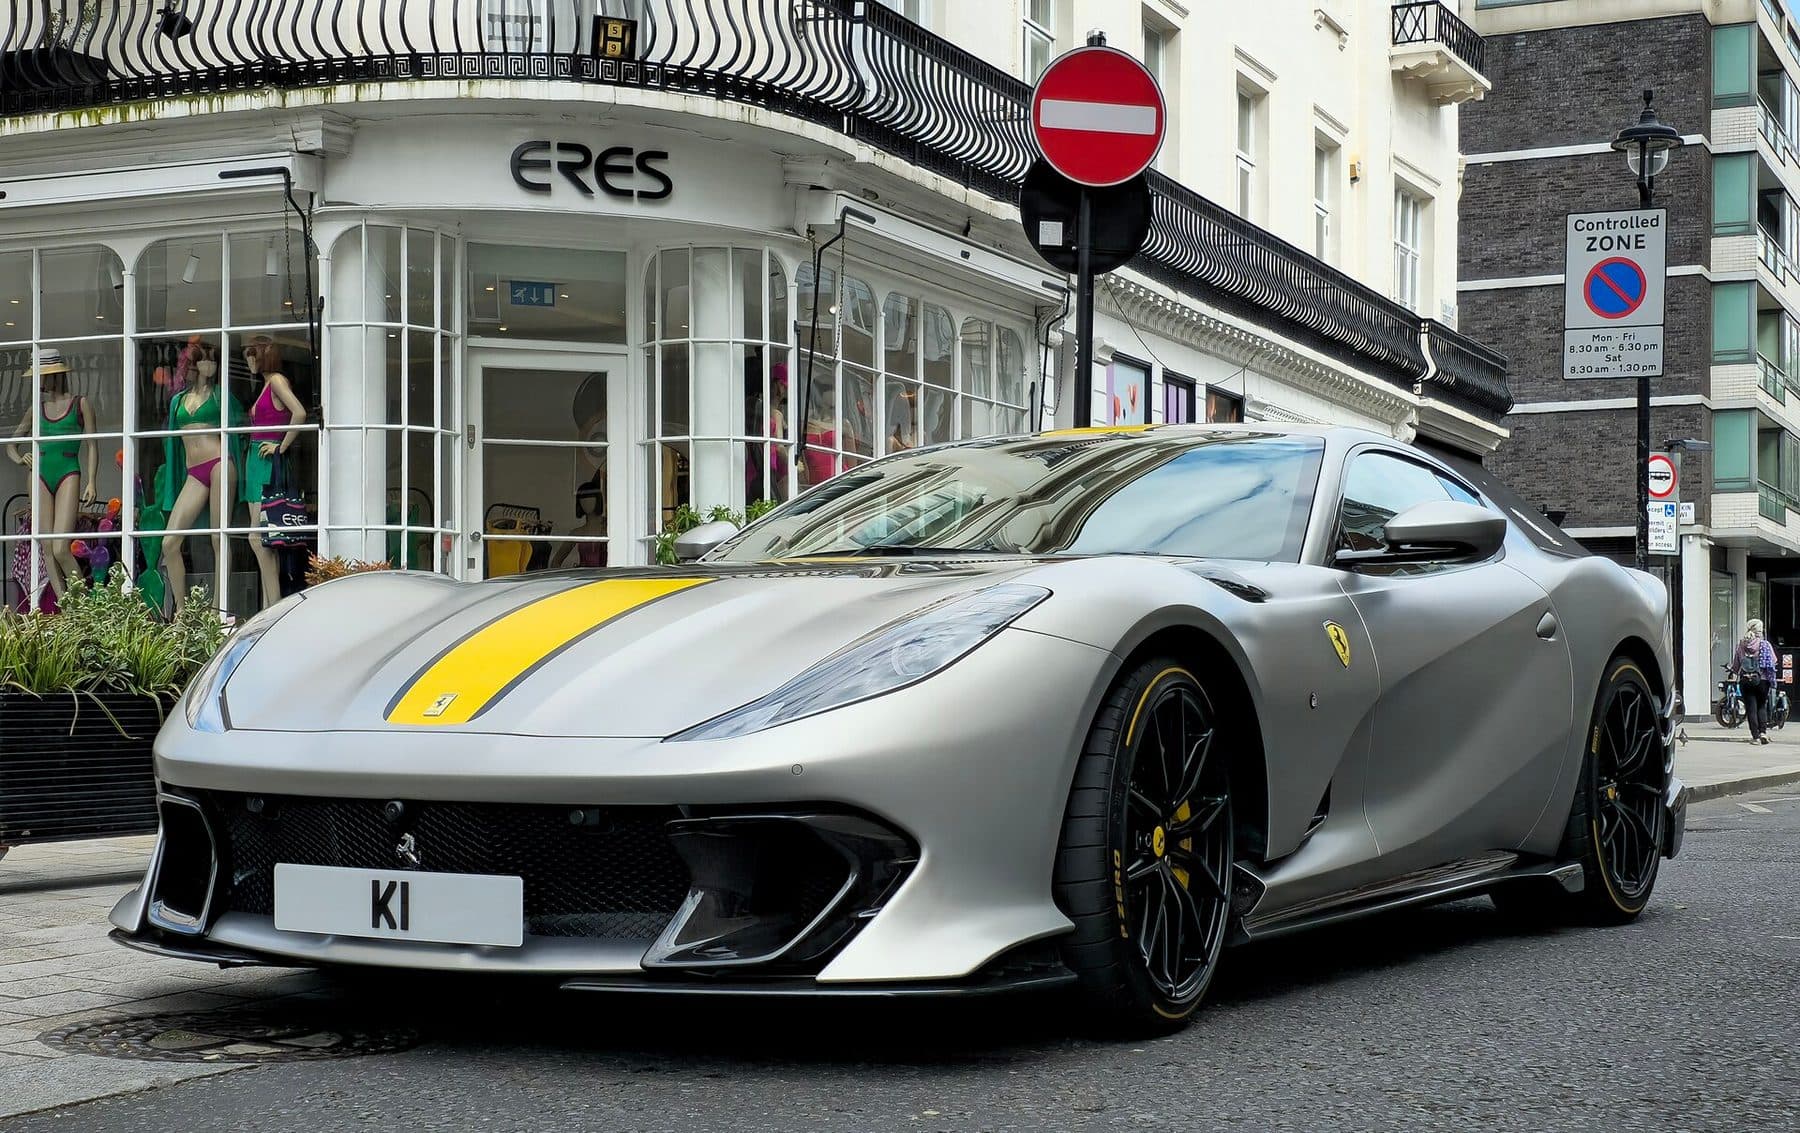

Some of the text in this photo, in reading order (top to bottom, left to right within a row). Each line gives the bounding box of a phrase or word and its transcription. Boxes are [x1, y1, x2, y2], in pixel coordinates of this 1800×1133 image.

[612, 26, 618, 35] 5
[611, 44, 617, 52] 9
[510, 140, 673, 199] ERES
[1574, 214, 1660, 231] Controlled
[1586, 234, 1646, 252] ZONE
[1592, 334, 1612, 342] Mon
[1623, 332, 1636, 340] Fri
[1569, 345, 1592, 353] 8.30
[1643, 343, 1658, 352] pm
[1605, 354, 1622, 362] Sat
[1570, 365, 1592, 374] 8.30
[1619, 363, 1640, 372] 1.30
[1642, 364, 1657, 372] pm
